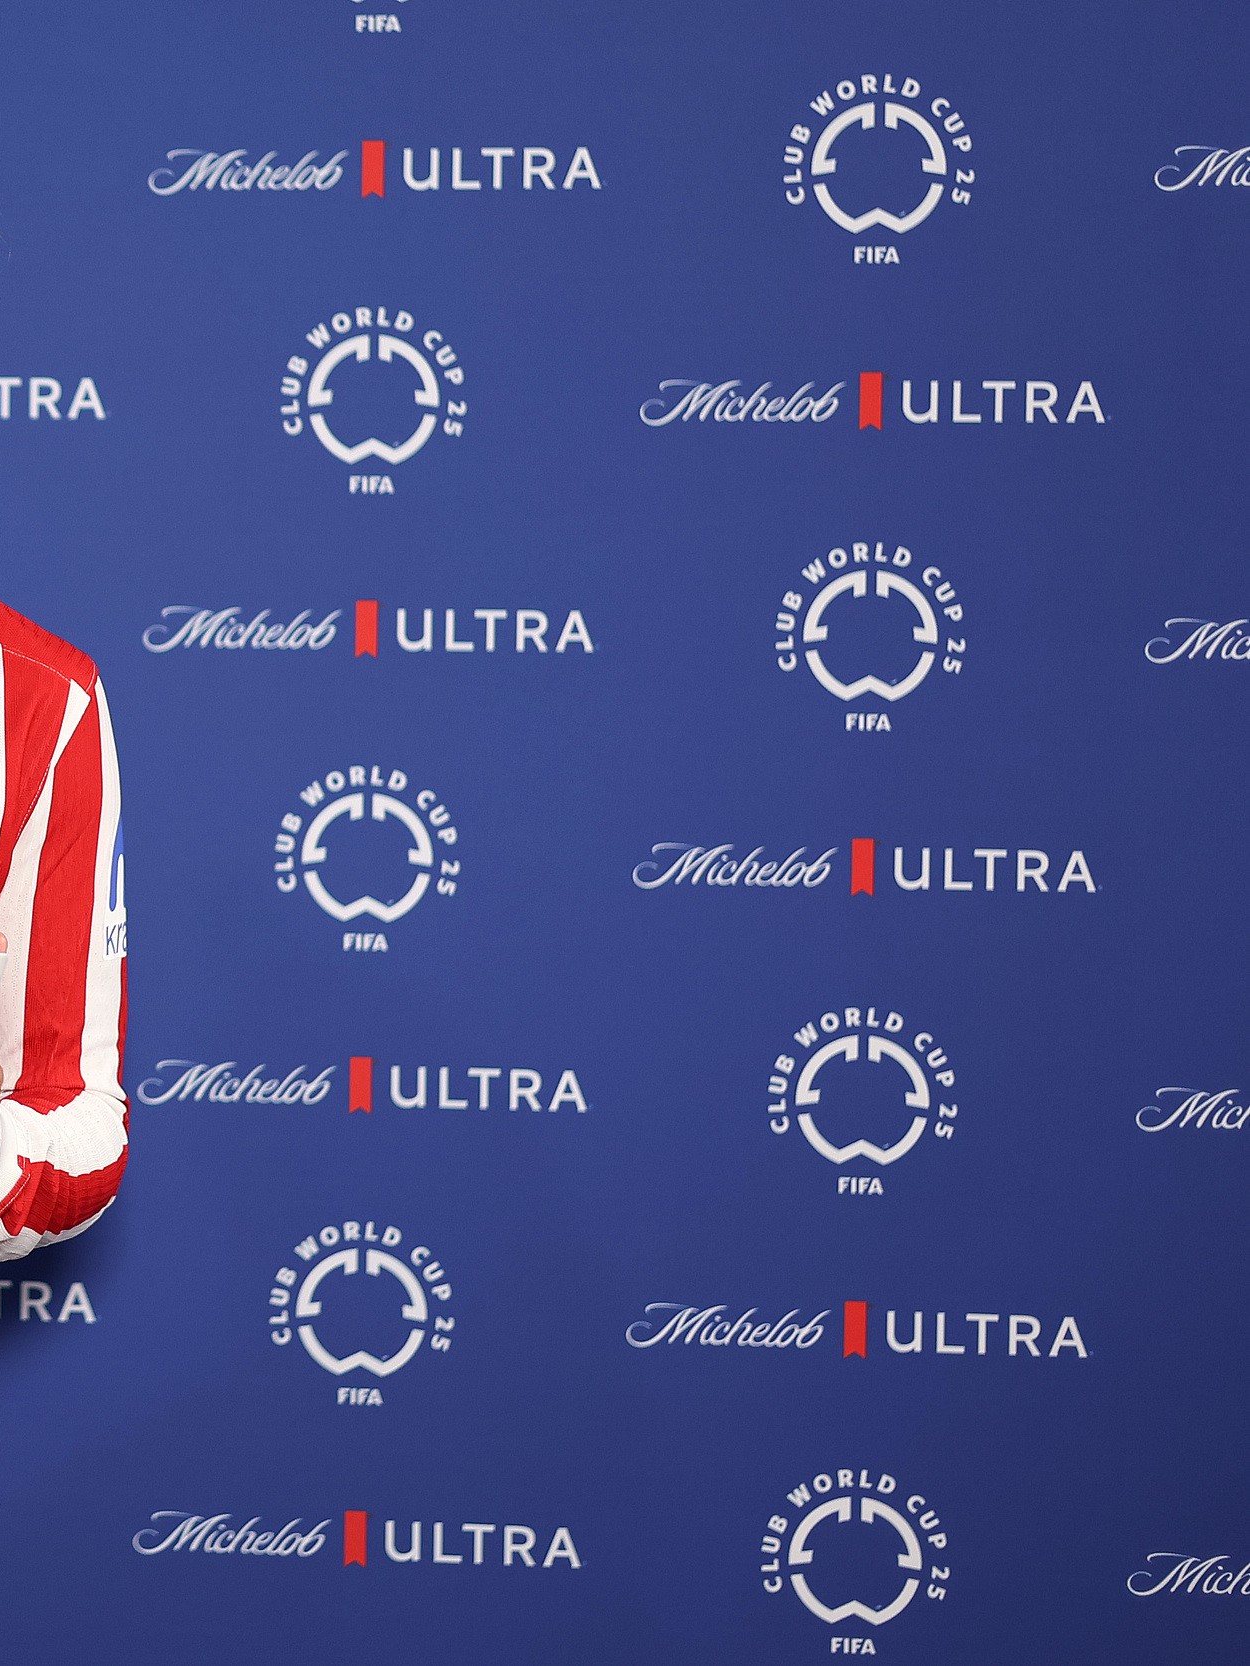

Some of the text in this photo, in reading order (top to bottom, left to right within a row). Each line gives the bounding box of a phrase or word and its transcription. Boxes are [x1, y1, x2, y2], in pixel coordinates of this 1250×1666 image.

[355, 14, 401, 33] FIFA
[783, 73, 975, 205] CLUB WORLD CUP 25
[147, 146, 602, 196] Michelob ULTRA
[854, 246, 900, 264] FIFA
[280, 306, 467, 437] CLUB WORLD CUP 25
[639, 378, 1105, 427] Michelob ULTRA
[349, 475, 394, 494] FIFA
[141, 605, 594, 654] Michelob ULTRA
[775, 542, 966, 674] CLUB WORLD CUP 25
[845, 713, 891, 732] FIFA
[274, 765, 461, 896] CLUB WORLD CUP 25
[632, 842, 1097, 893] Michelob ULTRA
[343, 933, 388, 952] FIFA
[136, 1059, 588, 1113] Michelob ULTRA
[767, 1007, 958, 1140] CLUB WORLD CUP 25
[837, 1176, 884, 1195] FIFA
[269, 1221, 455, 1352] CLUB WORLD CUP 25
[625, 1302, 1088, 1358] Michelob ULTRA
[337, 1387, 383, 1406] FIFA
[131, 1510, 582, 1569] Michelob ULTRA
[760, 1469, 950, 1601] CLUB WORLD CUP 25
[830, 1637, 876, 1655] FIFA
